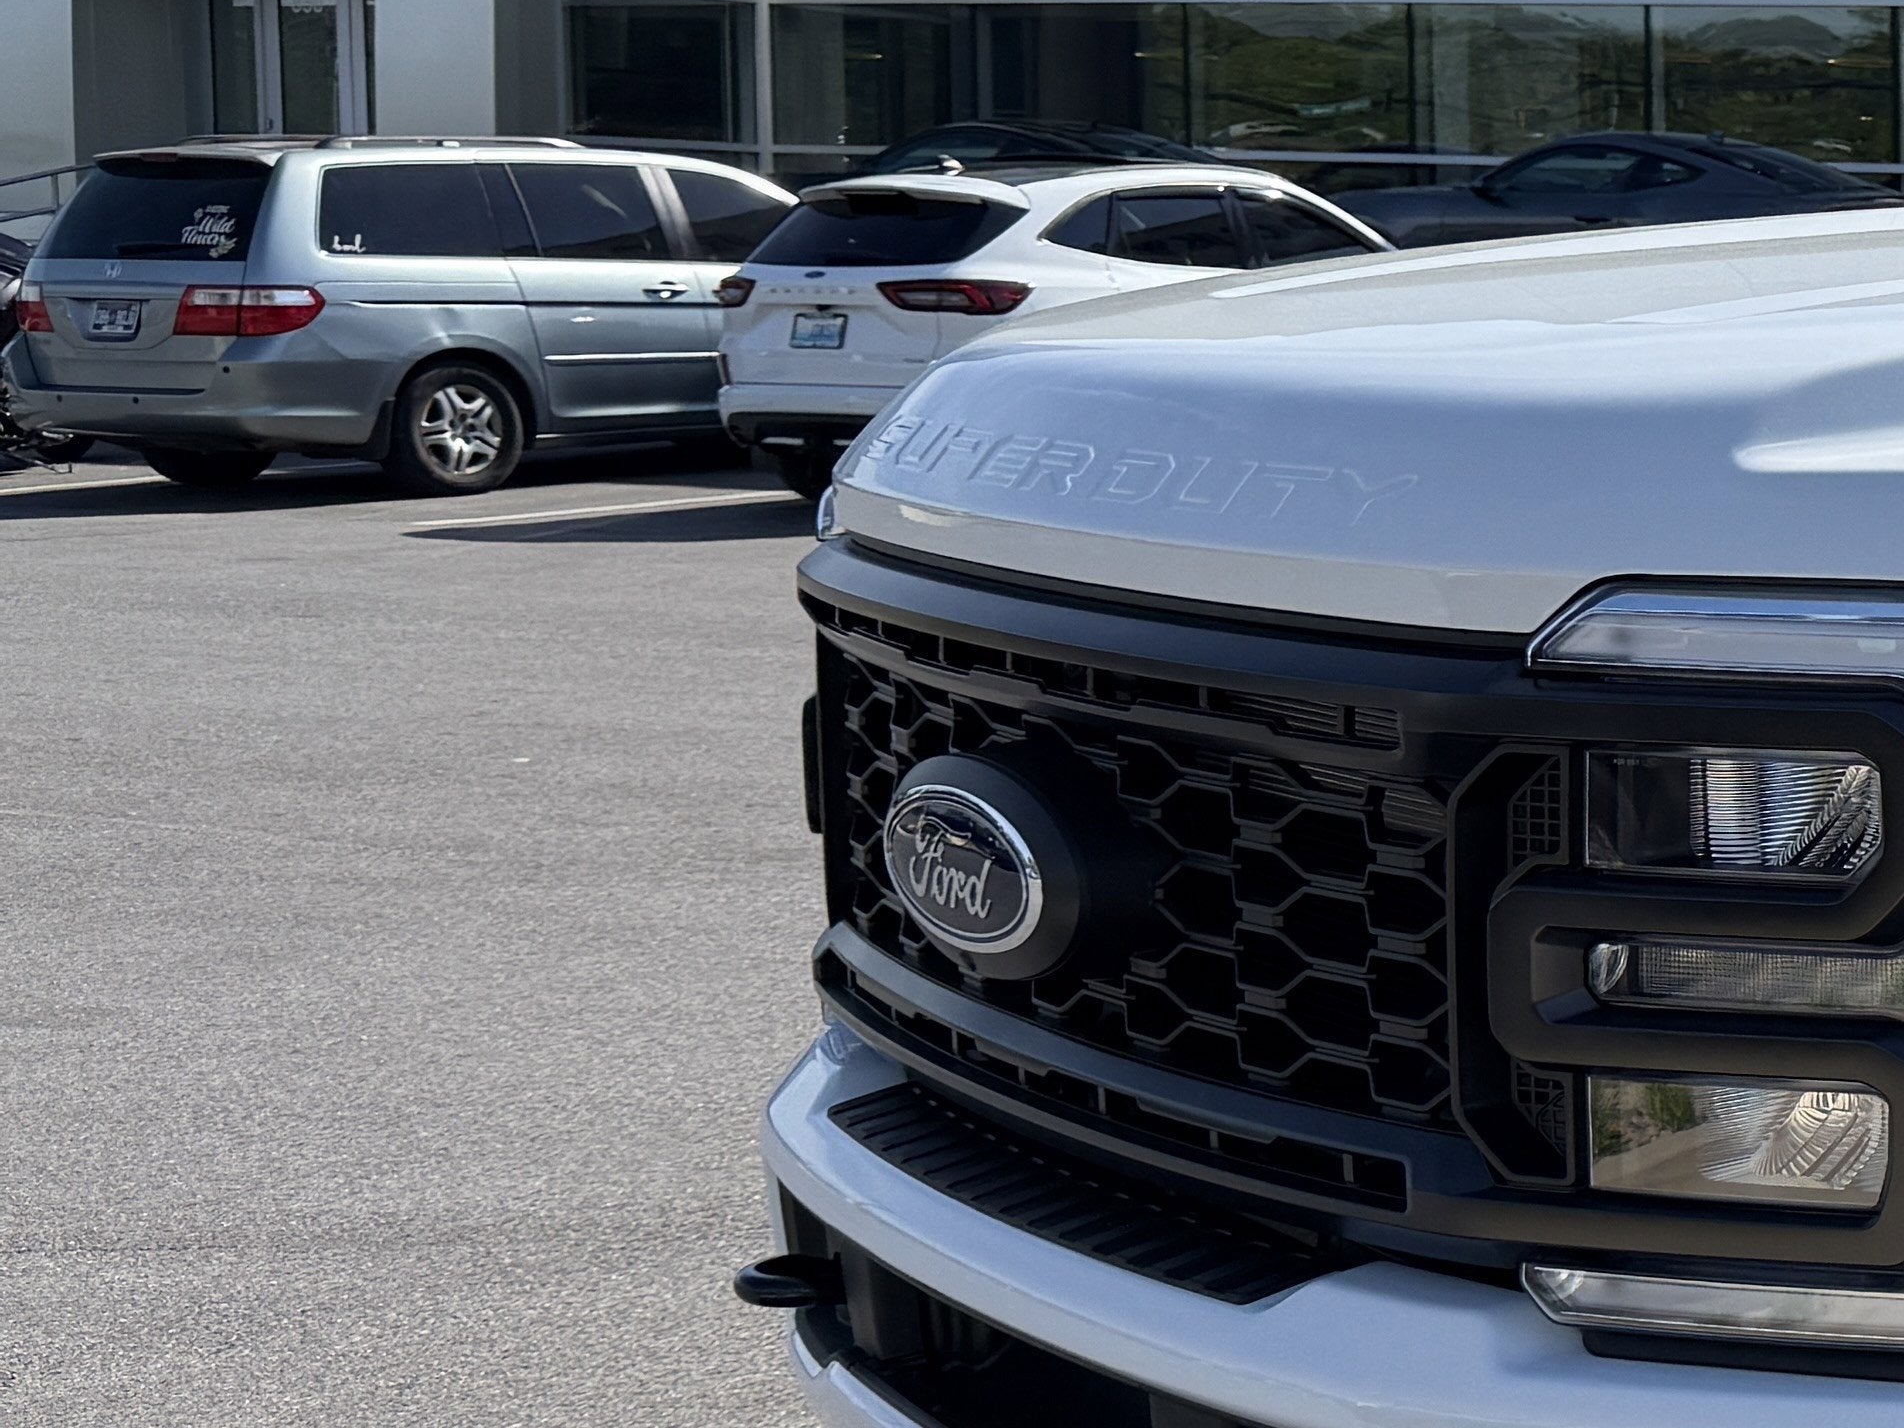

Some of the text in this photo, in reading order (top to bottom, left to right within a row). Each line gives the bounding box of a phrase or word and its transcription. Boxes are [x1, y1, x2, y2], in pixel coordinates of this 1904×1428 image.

[864, 417, 1419, 528] SUPER DUTY
[908, 814, 992, 919] Ford
